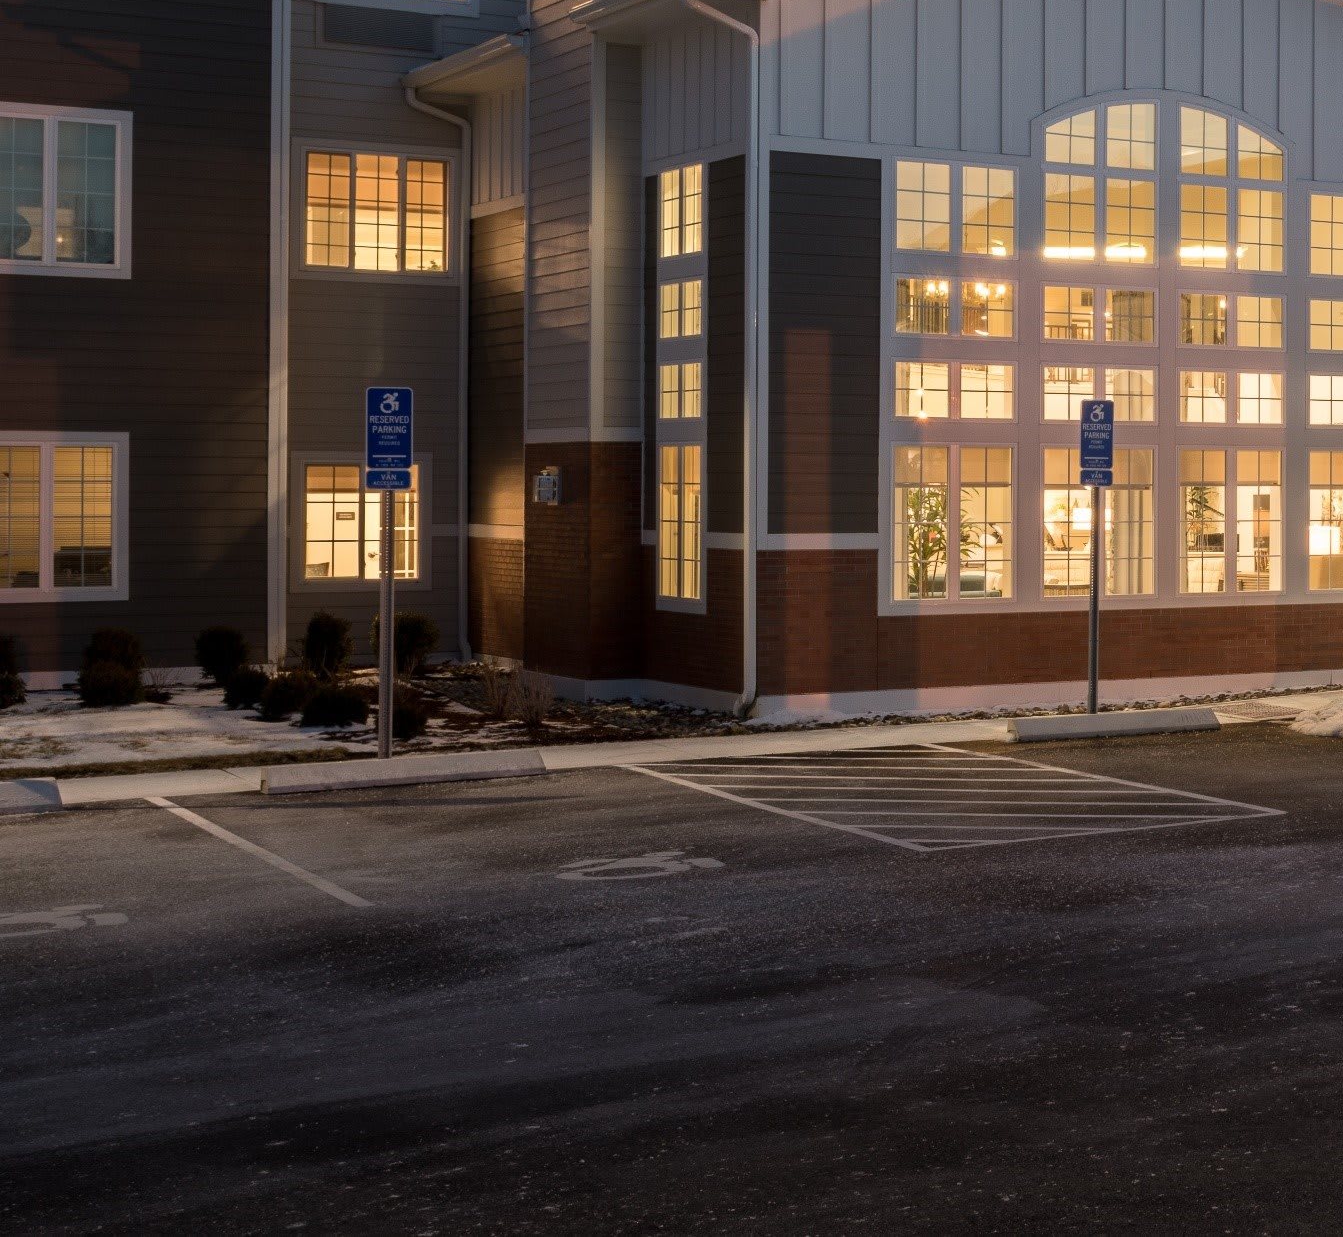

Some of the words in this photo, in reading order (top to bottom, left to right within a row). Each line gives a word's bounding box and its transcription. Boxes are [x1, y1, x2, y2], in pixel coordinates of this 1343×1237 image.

[369, 415, 410, 424] RESERVED
[372, 425, 407, 434] PARKING
[1082, 423, 1112, 431] RESERVED
